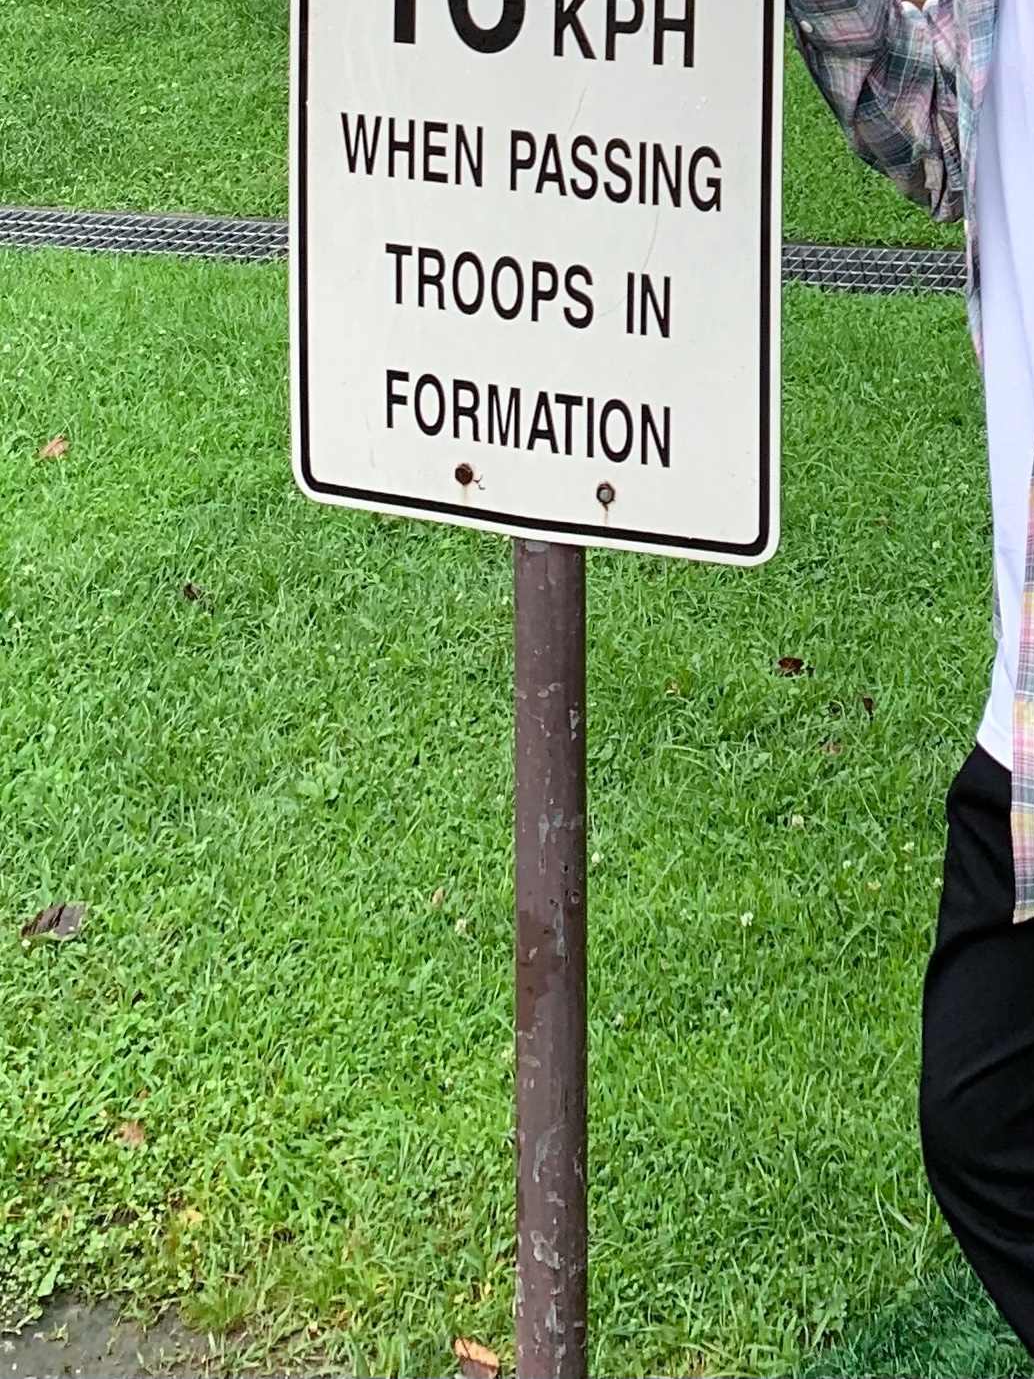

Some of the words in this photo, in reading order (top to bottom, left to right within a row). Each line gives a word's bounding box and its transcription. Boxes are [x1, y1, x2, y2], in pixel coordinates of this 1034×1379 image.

[340, 112, 483, 188] WHEN
[510, 129, 722, 212] PASSING
[385, 243, 594, 329] TROOPS
[626, 272, 671, 338] IN
[386, 369, 671, 469] FORMATION
